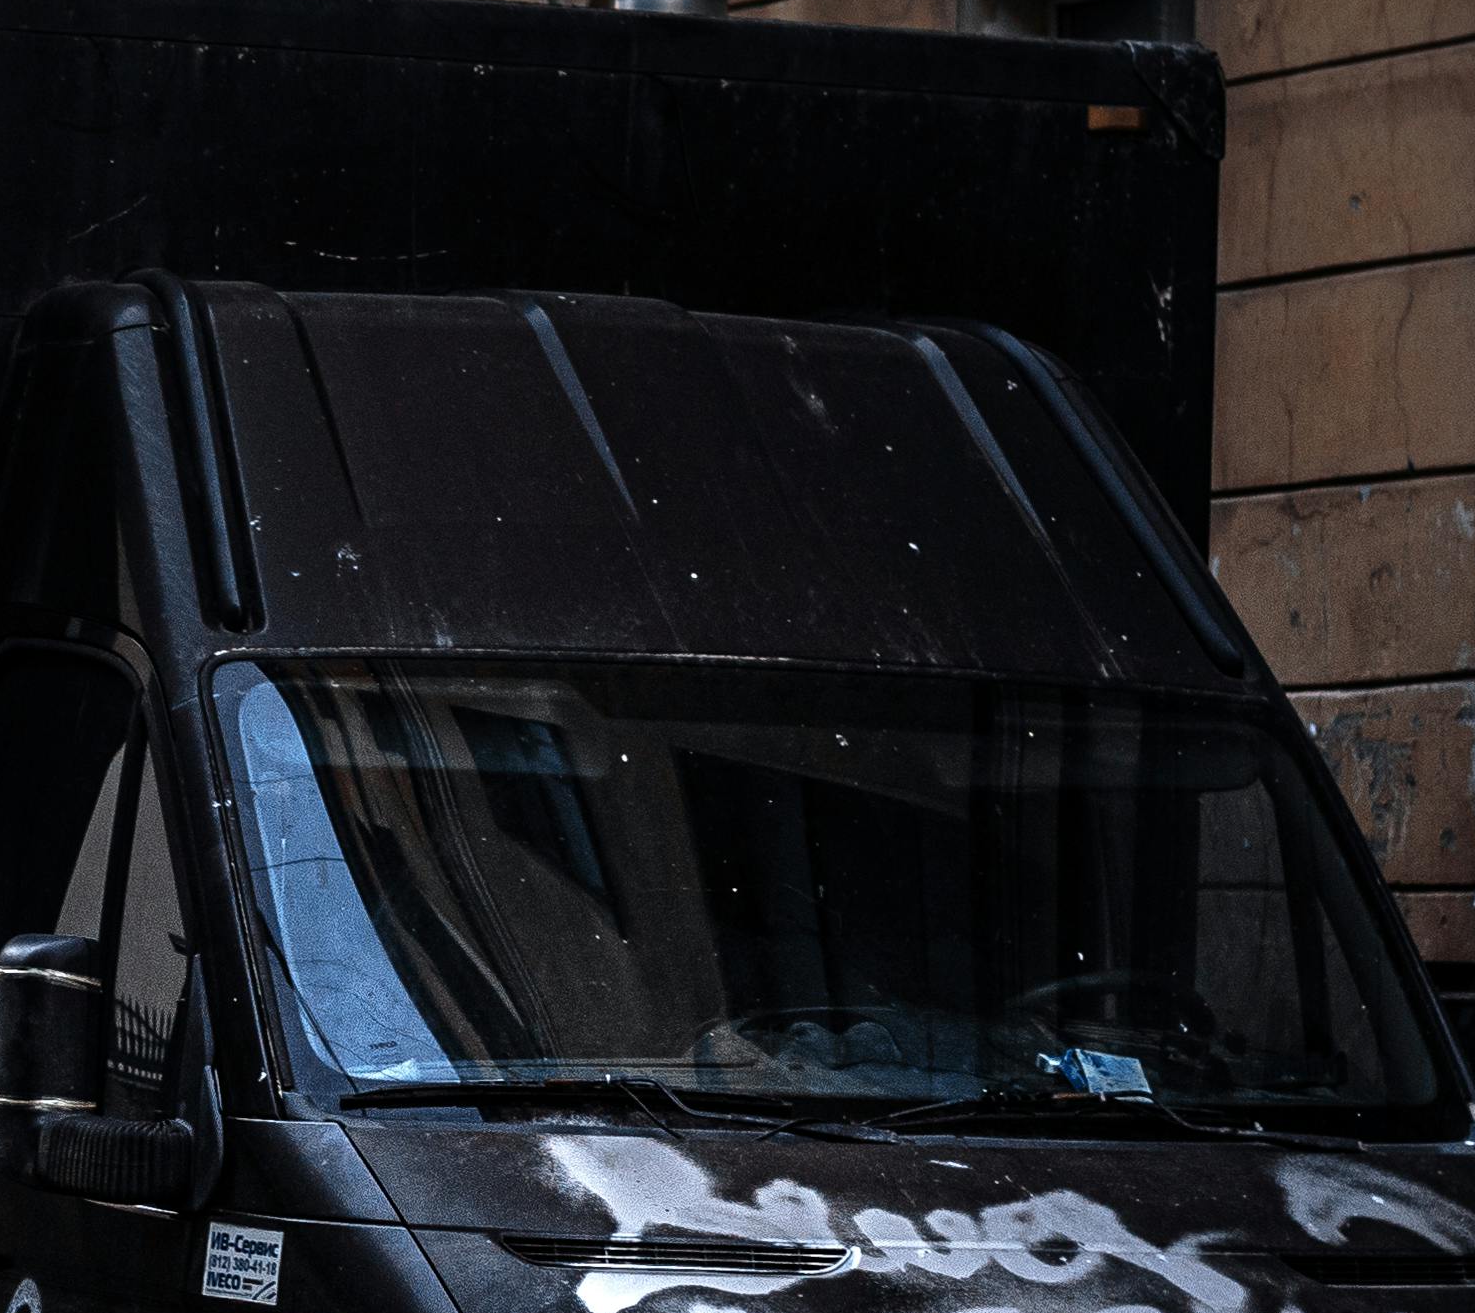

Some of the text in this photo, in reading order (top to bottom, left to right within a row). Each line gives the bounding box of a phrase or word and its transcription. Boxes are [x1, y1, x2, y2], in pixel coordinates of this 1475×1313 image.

[211, 1231, 279, 1258] ИВ-Сервис
[210, 1254, 231, 1273] (812)
[206, 1271, 241, 1290] IVECO
